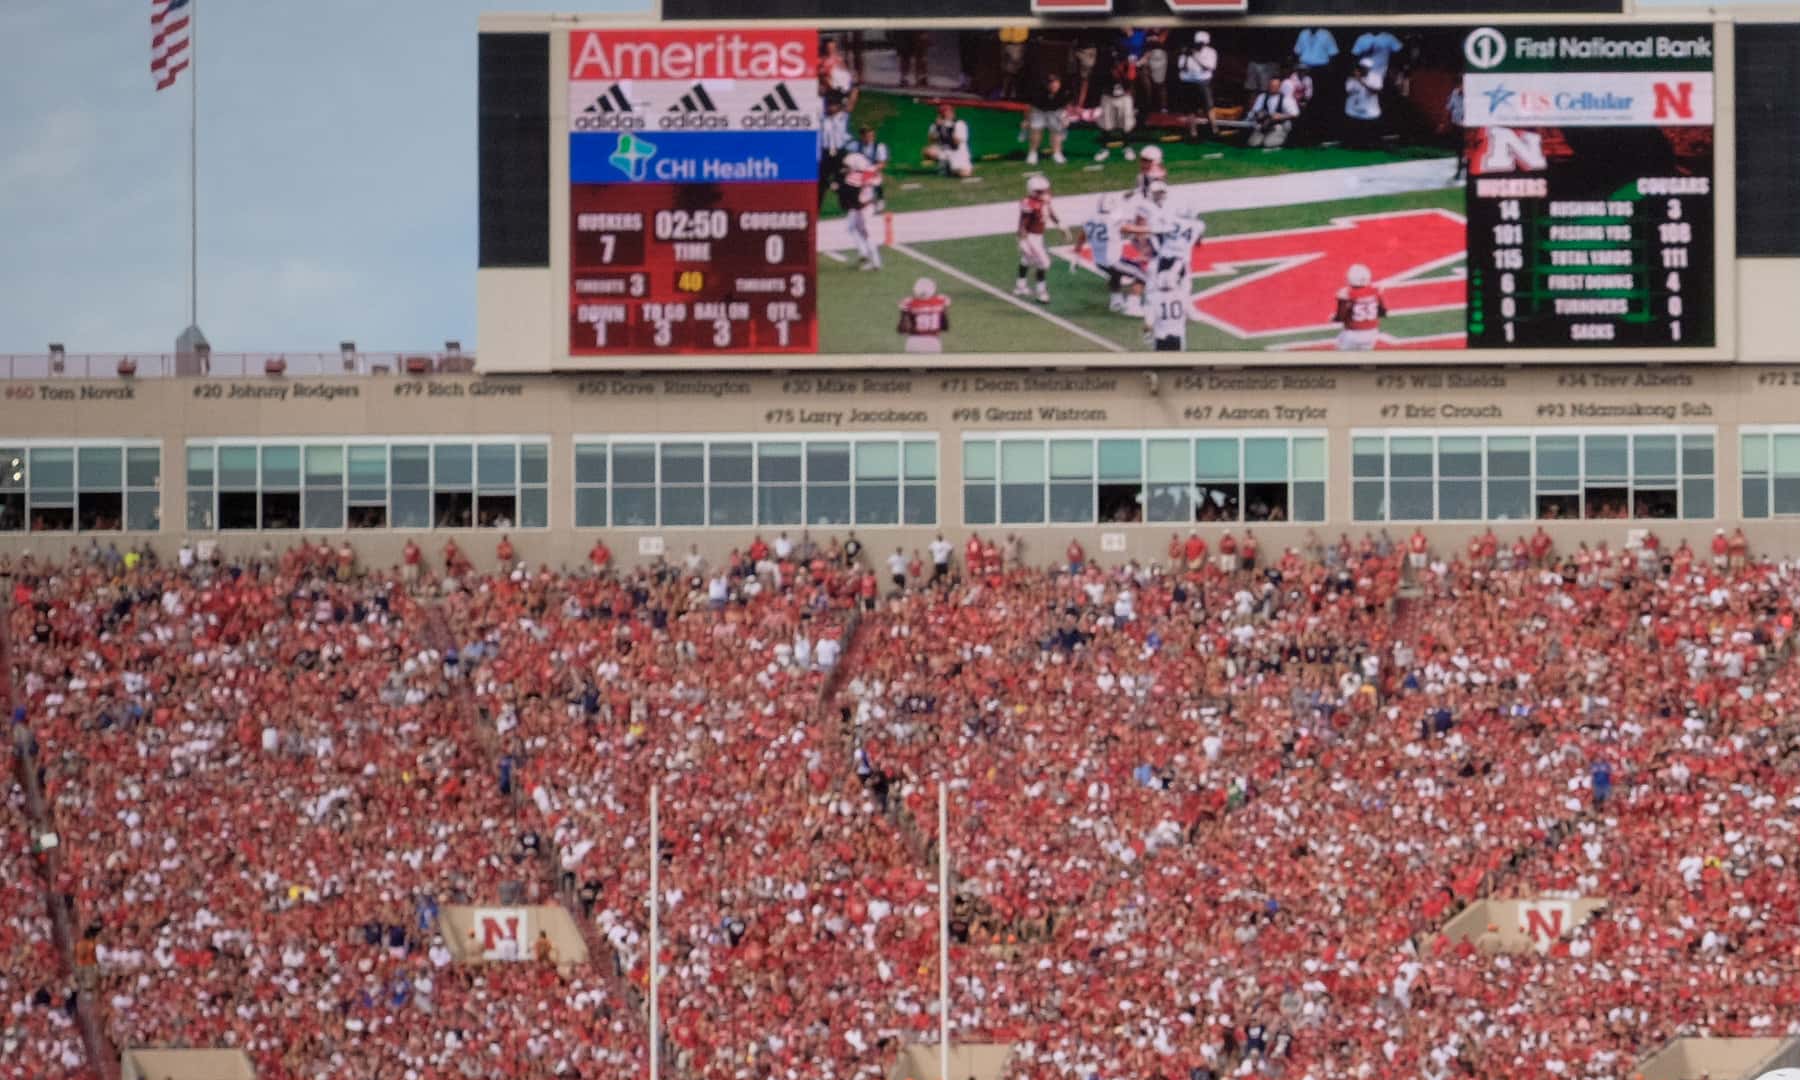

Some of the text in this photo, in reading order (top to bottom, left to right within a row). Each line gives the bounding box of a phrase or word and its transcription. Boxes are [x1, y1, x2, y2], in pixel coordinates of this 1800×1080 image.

[572, 31, 807, 79] Ameritas
[1514, 36, 1558, 59] First
[1560, 35, 1653, 58] National
[1656, 35, 1712, 58] Bank
[1555, 90, 1635, 111] Cellular
[1652, 81, 1694, 119] N
[576, 112, 645, 130] adidas
[659, 112, 729, 130] adidas
[741, 112, 811, 130] adidas
[655, 156, 779, 179] CHI Health
[654, 209, 729, 240] 02:50
[600, 234, 617, 263] 7
[765, 233, 785, 263] 0
[1160, 300, 1184, 321] 10
[611, 380, 655, 395] Dave
[816, 379, 857, 394] Mike
[974, 377, 1020, 393] Dean
[1412, 373, 1443, 388] Will
[1592, 372, 1631, 388] Trev
[1634, 372, 1694, 388] Alberts
[1757, 371, 1787, 386] #72
[39, 386, 76, 401] Tom
[80, 386, 136, 400] Novak
[227, 384, 289, 401] Johnny
[293, 383, 360, 400] Rodgers
[394, 381, 524, 397] #79 Rich Glover
[765, 408, 928, 427] #75 Larry Jacobson
[985, 407, 1033, 423] Grant
[1038, 406, 1108, 423] Wistrom
[1184, 404, 1328, 422] #67 Aaron Taylor
[1380, 402, 1503, 419] #7 Eric Crouch
[1536, 402, 1566, 418] #93
[1681, 400, 1713, 418] Suh
[481, 916, 520, 951] N
[1526, 909, 1563, 944] N
